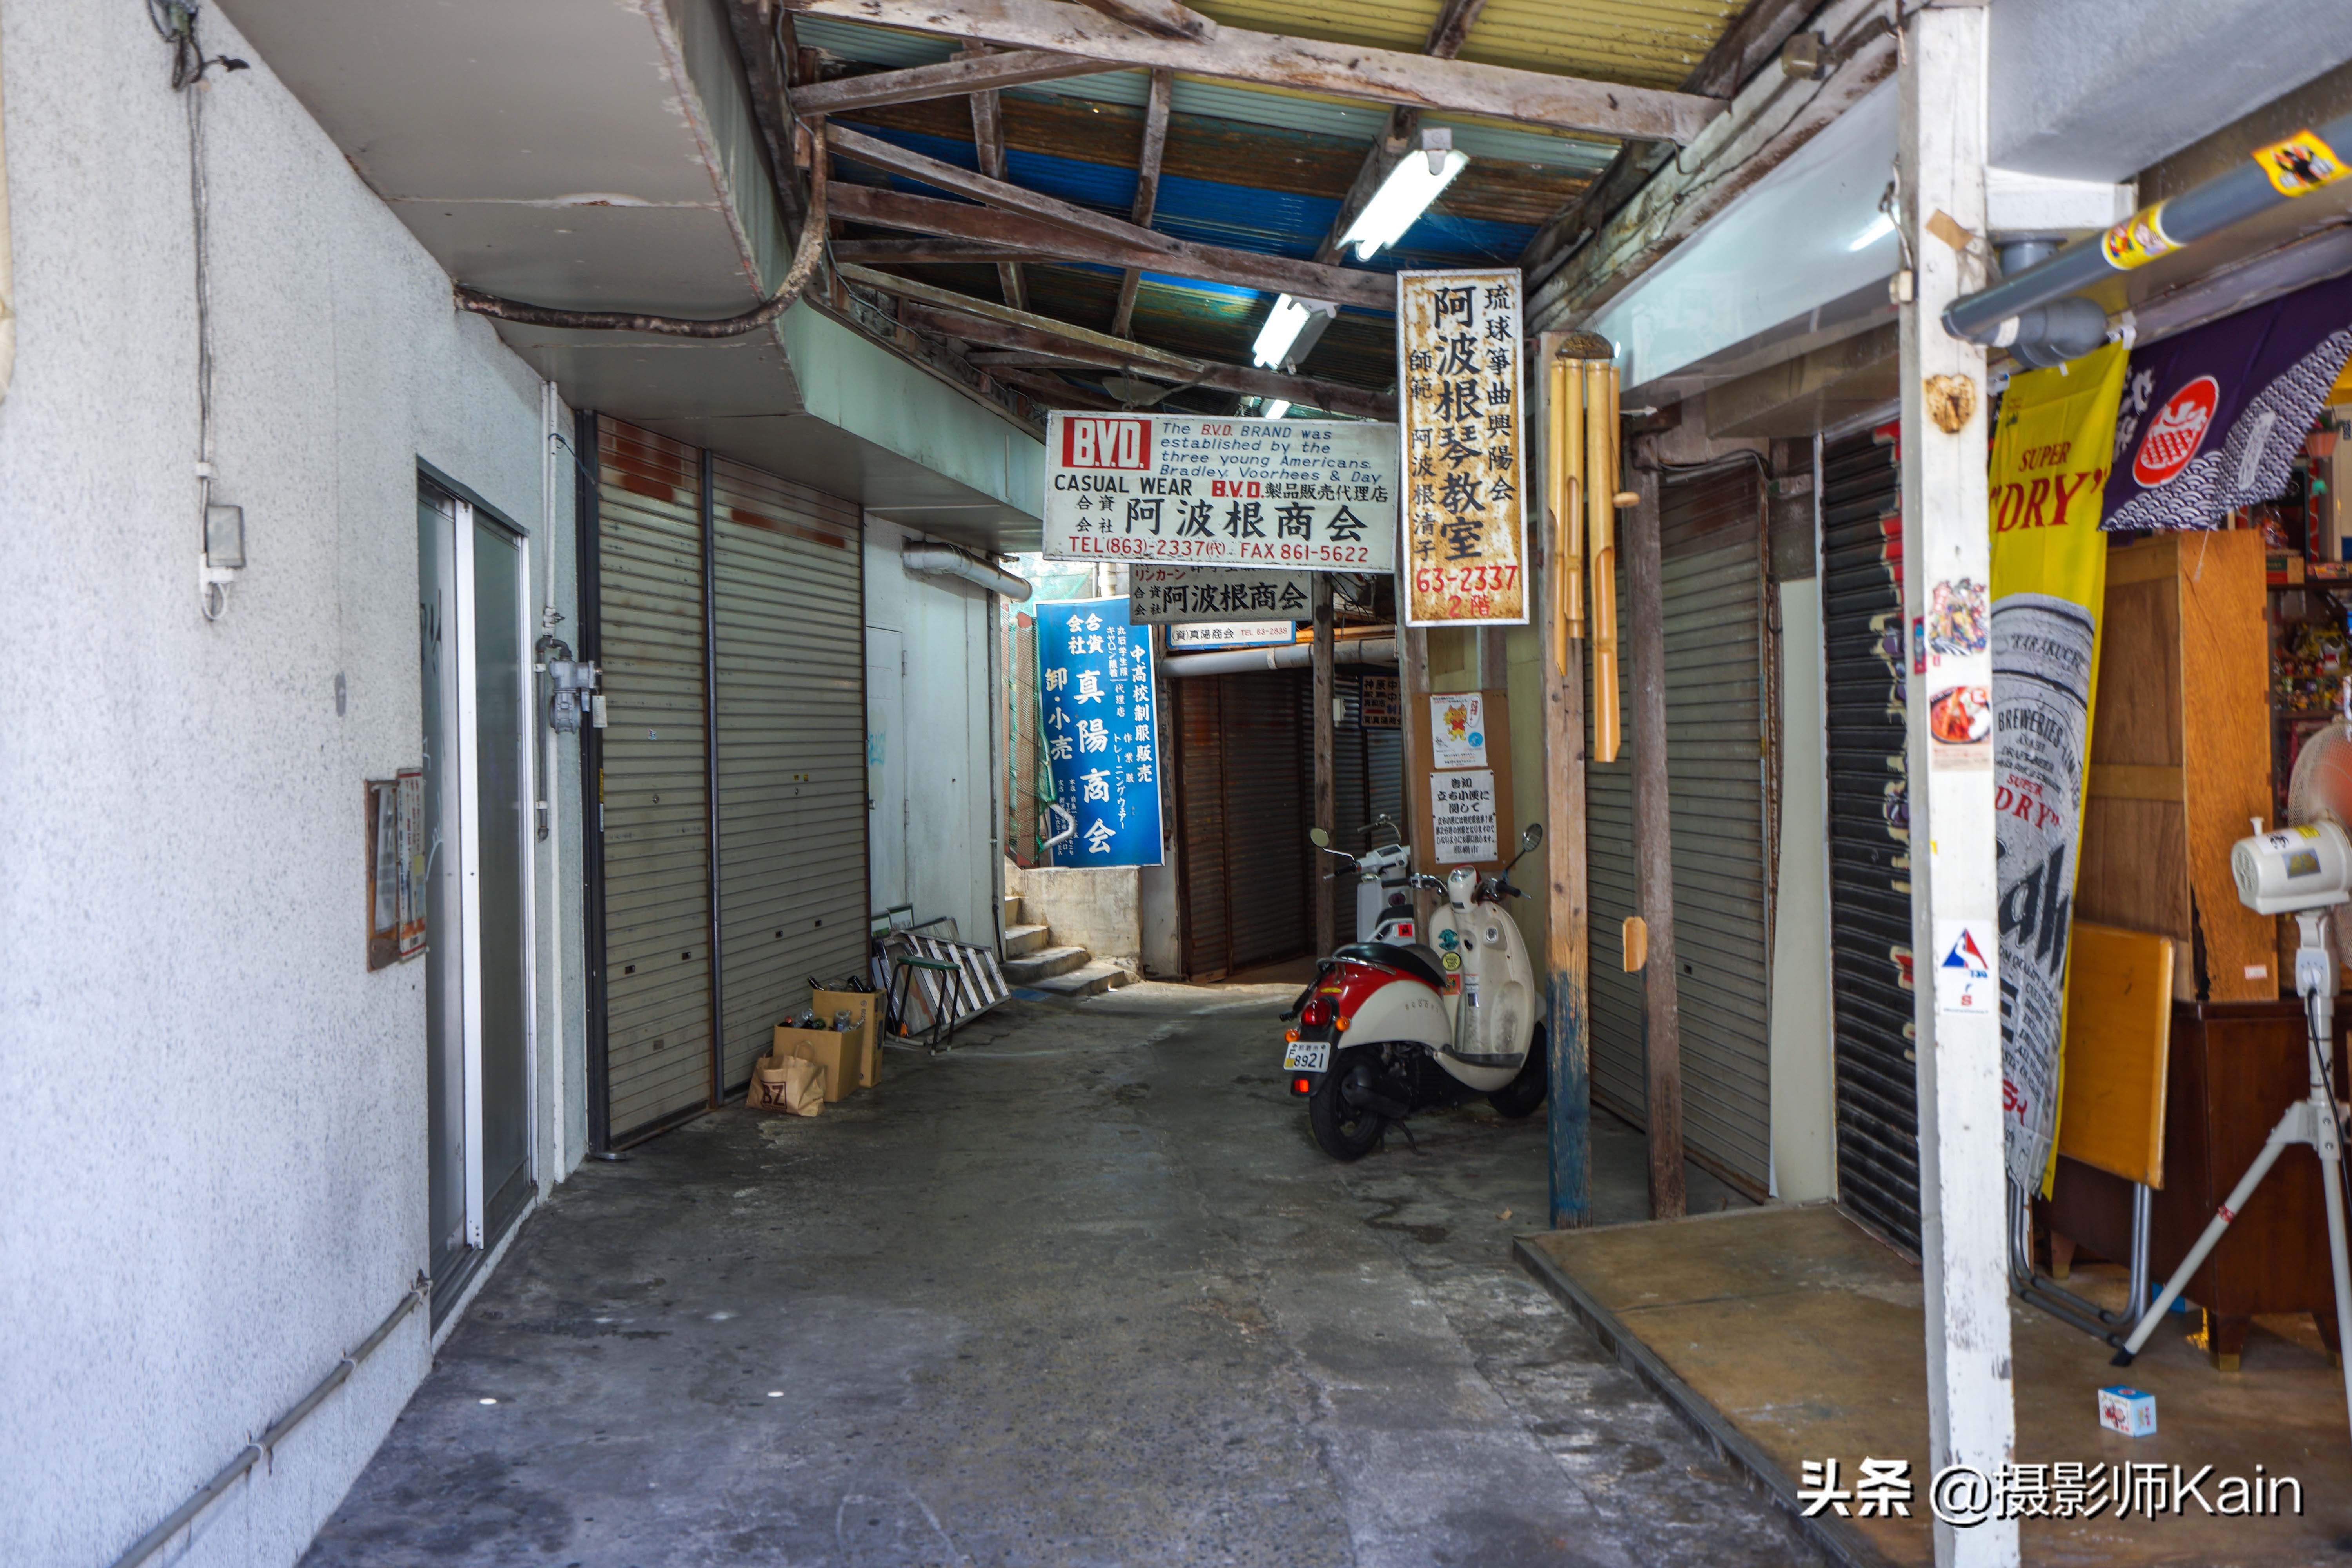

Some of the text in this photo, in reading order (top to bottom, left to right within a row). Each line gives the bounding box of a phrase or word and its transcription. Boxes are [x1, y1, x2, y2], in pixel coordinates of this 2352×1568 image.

[1163, 422, 1332, 439] The B.V.D. BRAND was
[1433, 286, 1486, 561] 阿波根琴教室
[1073, 419, 1144, 468] B.V.D.
[1161, 437, 1330, 456] established by the
[1161, 452, 1209, 463] three
[1220, 455, 1270, 467] young
[2019, 441, 2071, 472] SUPER
[1054, 474, 1129, 493] CASUAL
[1140, 477, 1192, 496] WEAR
[1240, 467, 1320, 481] Voorhees
[1330, 471, 1340, 481] &
[1351, 471, 1382, 485] Day
[1076, 516, 1115, 534] 会社
[1125, 498, 1368, 543] 阿波根商会
[1241, 543, 1275, 559] FAX
[1281, 544, 1368, 562] 861-5622
[1136, 569, 1186, 581] リンカーン
[1416, 565, 1518, 593] 63-2337
[1163, 580, 1308, 613] 阿波根商会
[1073, 669, 1116, 854] 真陽商会
[1437, 790, 1490, 801] 立ち小便に
[2007, 774, 2043, 797] SUPER
[1449, 802, 1480, 814] 関して
[1294, 1053, 1323, 1068] 8921
[763, 1084, 784, 1106] BZ
